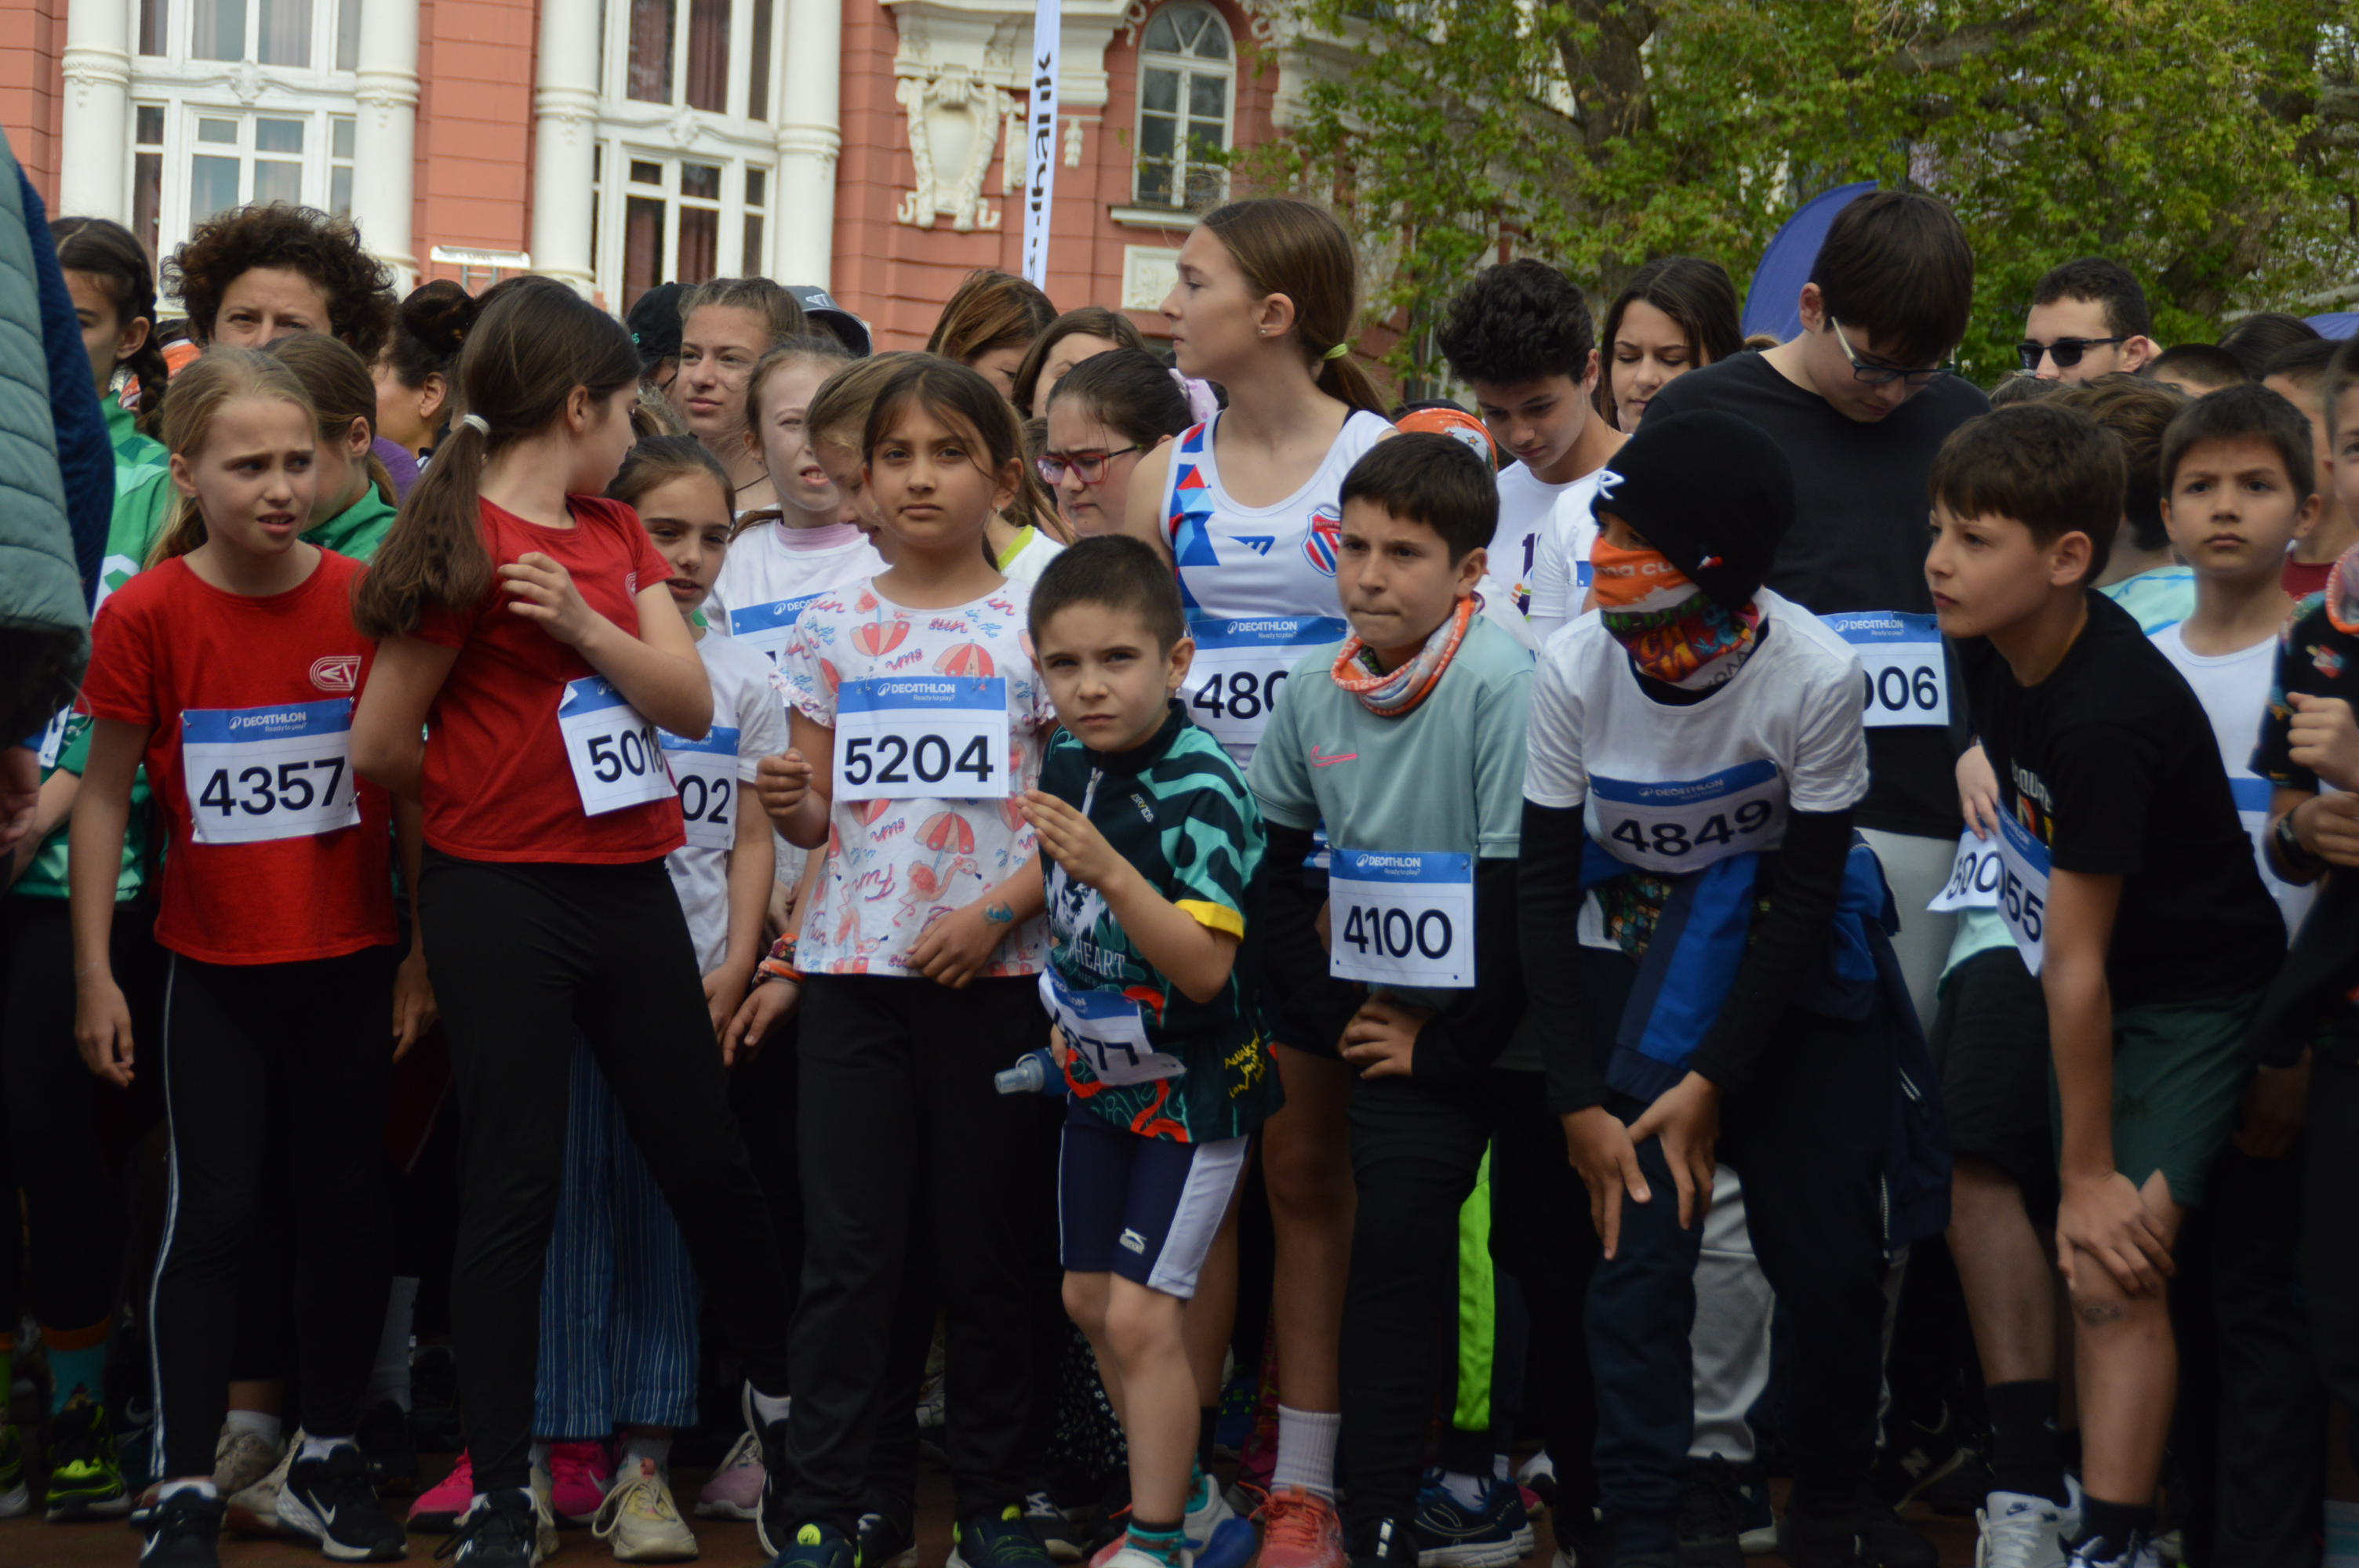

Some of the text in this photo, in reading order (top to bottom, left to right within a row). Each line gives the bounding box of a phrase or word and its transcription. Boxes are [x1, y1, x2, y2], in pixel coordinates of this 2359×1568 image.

[1522, 533, 1542, 579] 1
[1238, 621, 1298, 632] DECATHLON
[1850, 619, 1904, 630] DECATHLON
[891, 683, 956, 695] DECATHLON
[242, 711, 307, 728] DECATHLON
[265, 724, 285, 733] Ready
[844, 734, 994, 786] 5204
[199, 755, 345, 816] 4357
[677, 775, 731, 824] 02
[1655, 779, 1724, 797] DECATHLON
[1612, 800, 1772, 856] 4849
[1369, 856, 1421, 867] DECATHLON
[1997, 855, 2044, 942] 55
[1343, 905, 1452, 960] 4100
[1075, 940, 1125, 979] HEART
